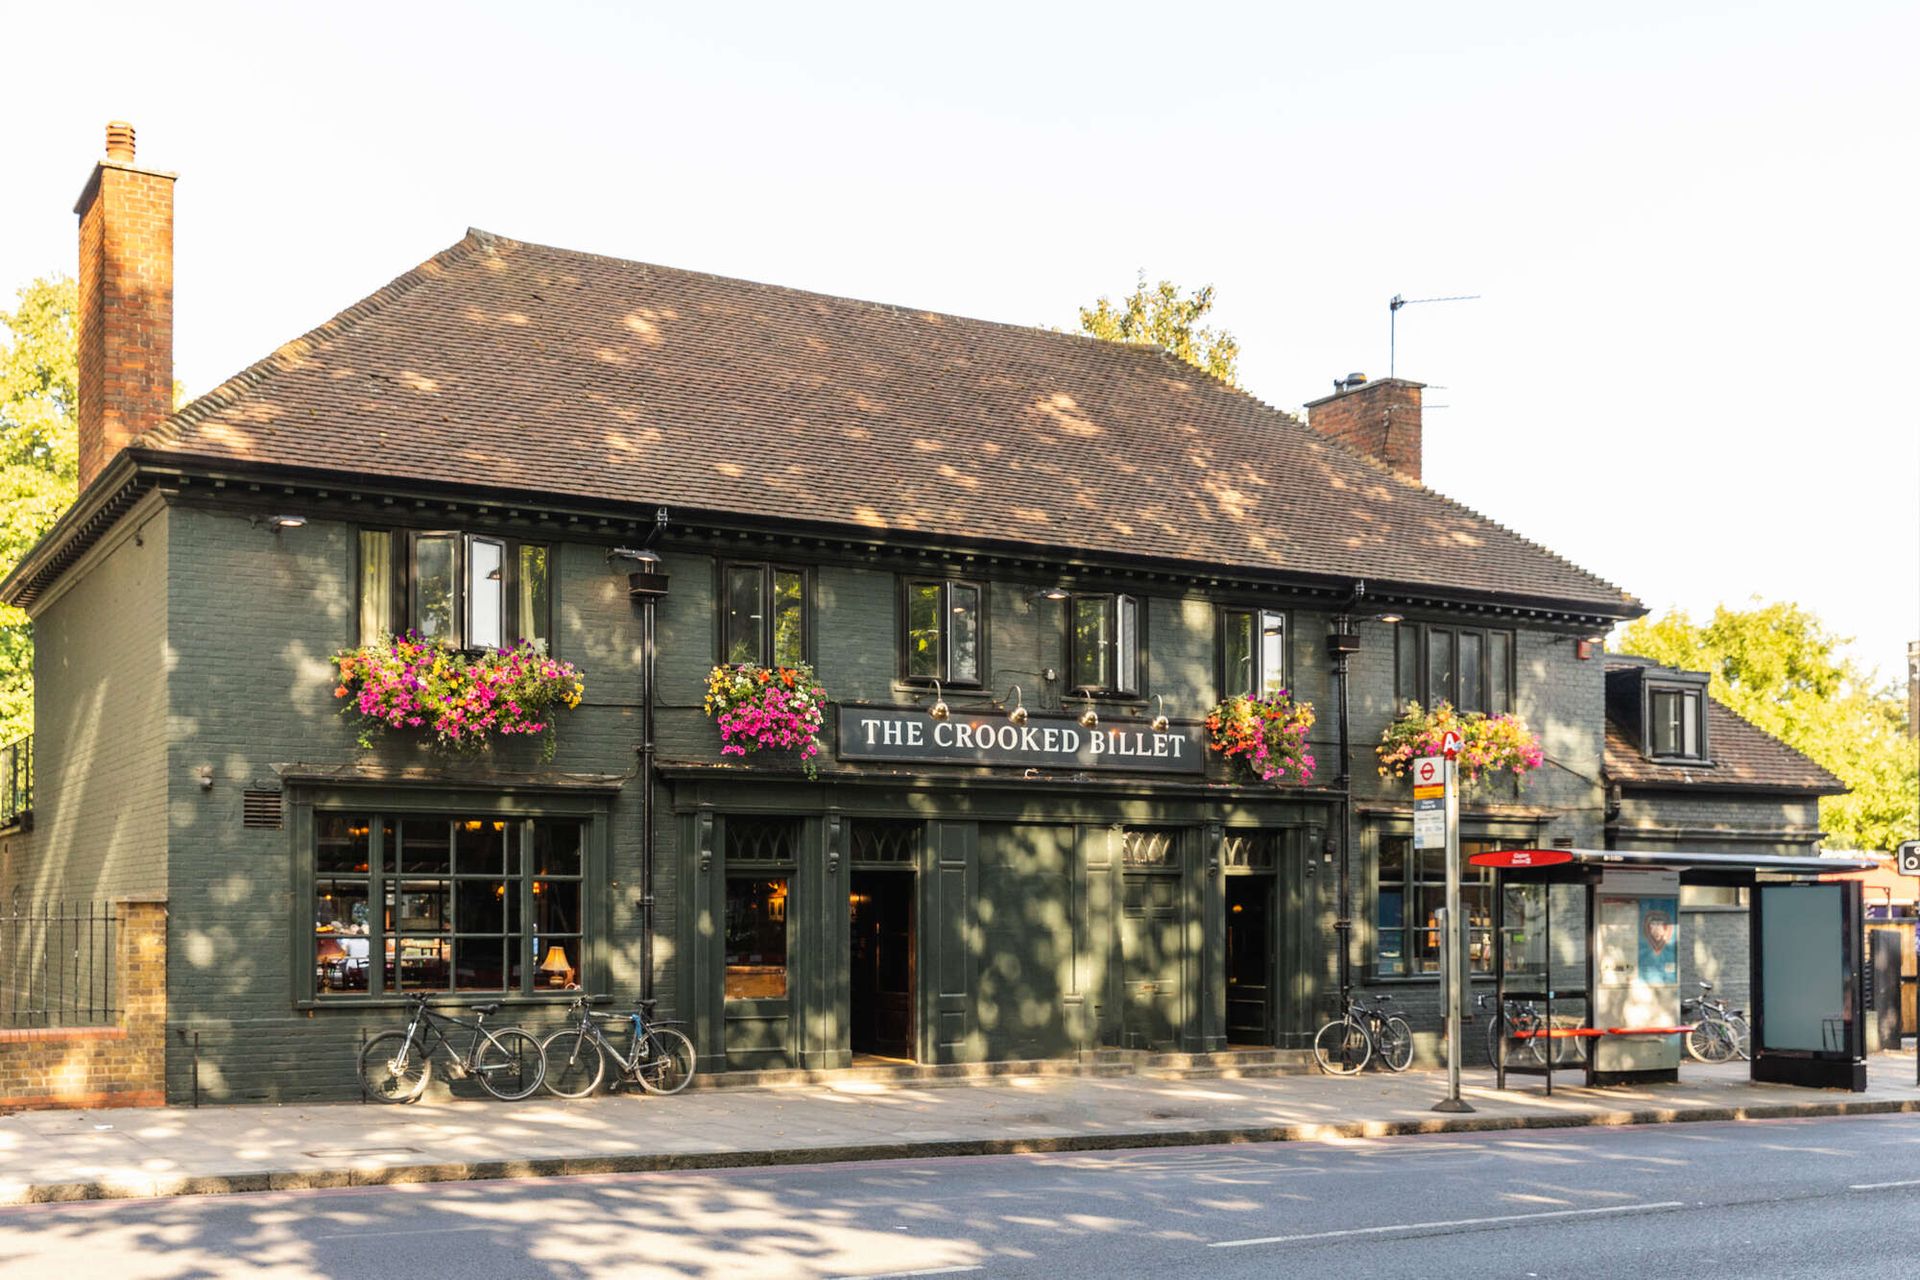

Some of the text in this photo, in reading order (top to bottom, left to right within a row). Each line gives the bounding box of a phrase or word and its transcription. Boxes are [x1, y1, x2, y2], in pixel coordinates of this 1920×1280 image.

[861, 719, 1186, 758] THE CROOKED BILLET
[1443, 732, 1457, 752] A
